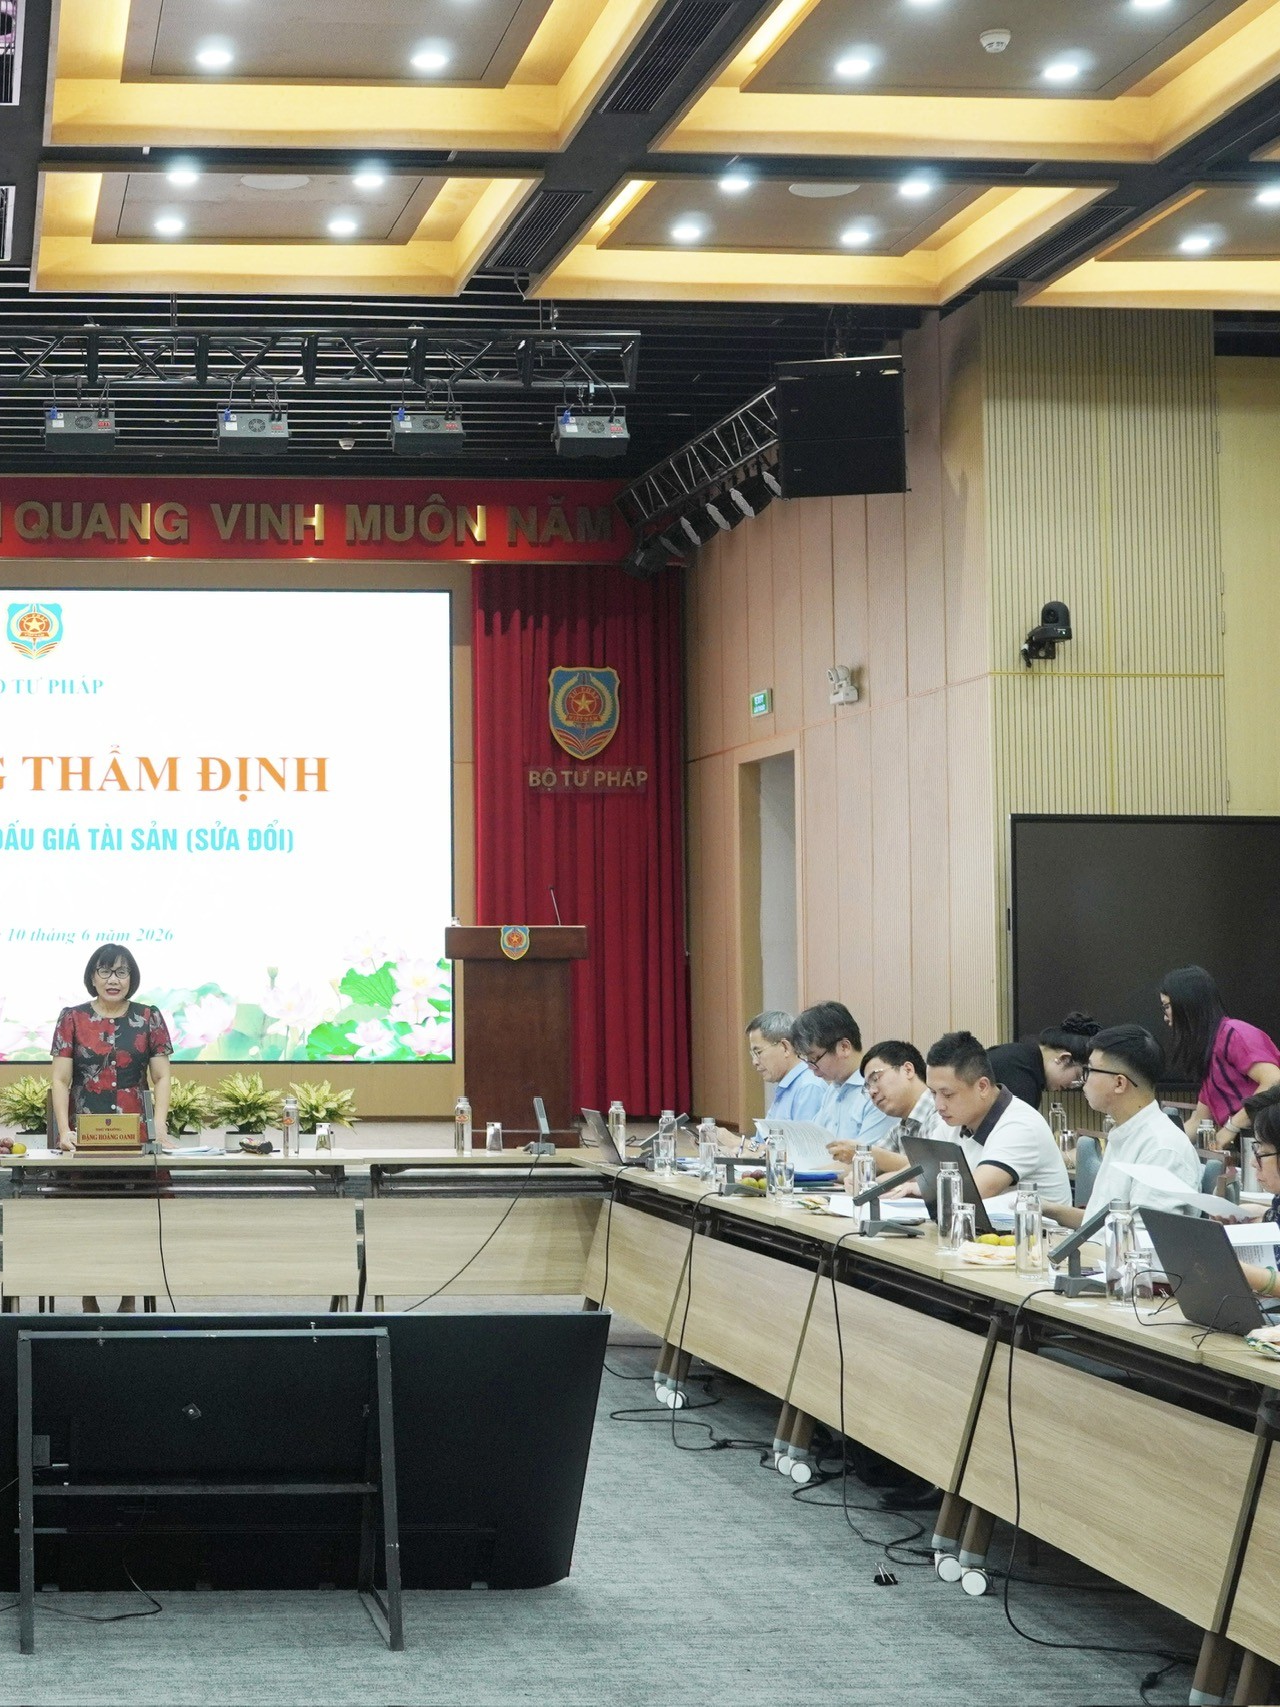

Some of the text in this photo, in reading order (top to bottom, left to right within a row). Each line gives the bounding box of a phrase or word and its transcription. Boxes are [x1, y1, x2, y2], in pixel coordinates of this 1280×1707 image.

[14, 500, 190, 541] QUANG
[210, 503, 325, 541] VINH
[345, 493, 487, 542] MUÔN
[507, 495, 614, 542] NĂM
[49, 674, 105, 695] PHÁP
[22, 745, 181, 792] THẨM
[196, 756, 331, 802] ĐỊNH
[528, 767, 649, 792] BỘ TƯ PHÁP
[42, 823, 80, 851] GIÁ
[88, 823, 122, 851] TÀI
[130, 820, 178, 851] SẢN
[186, 820, 240, 853] (SỬA
[247, 819, 294, 853] ĐỔI)
[6, 927, 26, 942] 10
[30, 927, 76, 945] tháng
[81, 928, 91, 942] 6
[95, 928, 131, 942] năm
[136, 927, 174, 942] 2026
